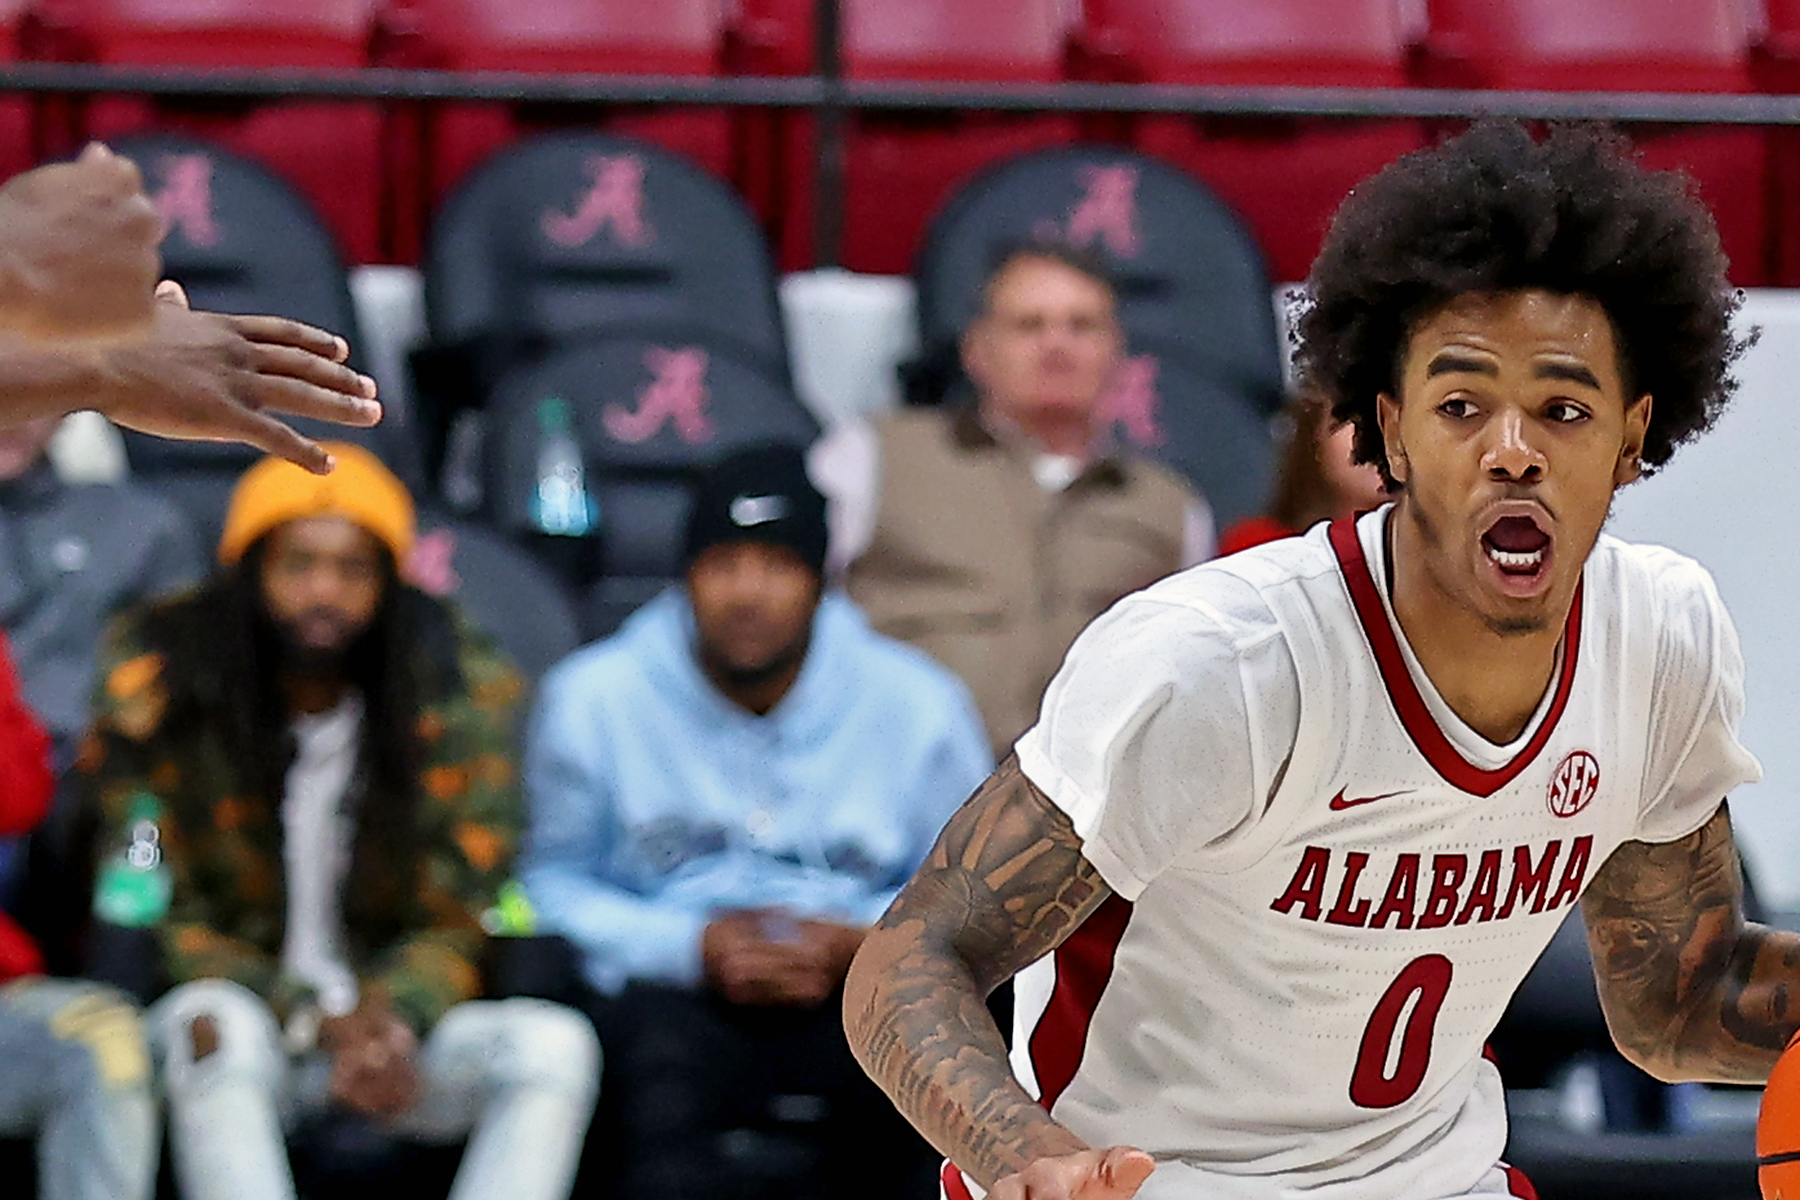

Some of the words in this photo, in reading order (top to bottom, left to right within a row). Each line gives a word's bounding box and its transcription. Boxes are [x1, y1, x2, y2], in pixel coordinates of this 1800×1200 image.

[540, 154, 655, 250] A
[602, 346, 713, 446] A
[1549, 754, 1599, 816] SEC
[1269, 834, 1594, 930] ALABAMA
[1348, 953, 1453, 1110] 0
